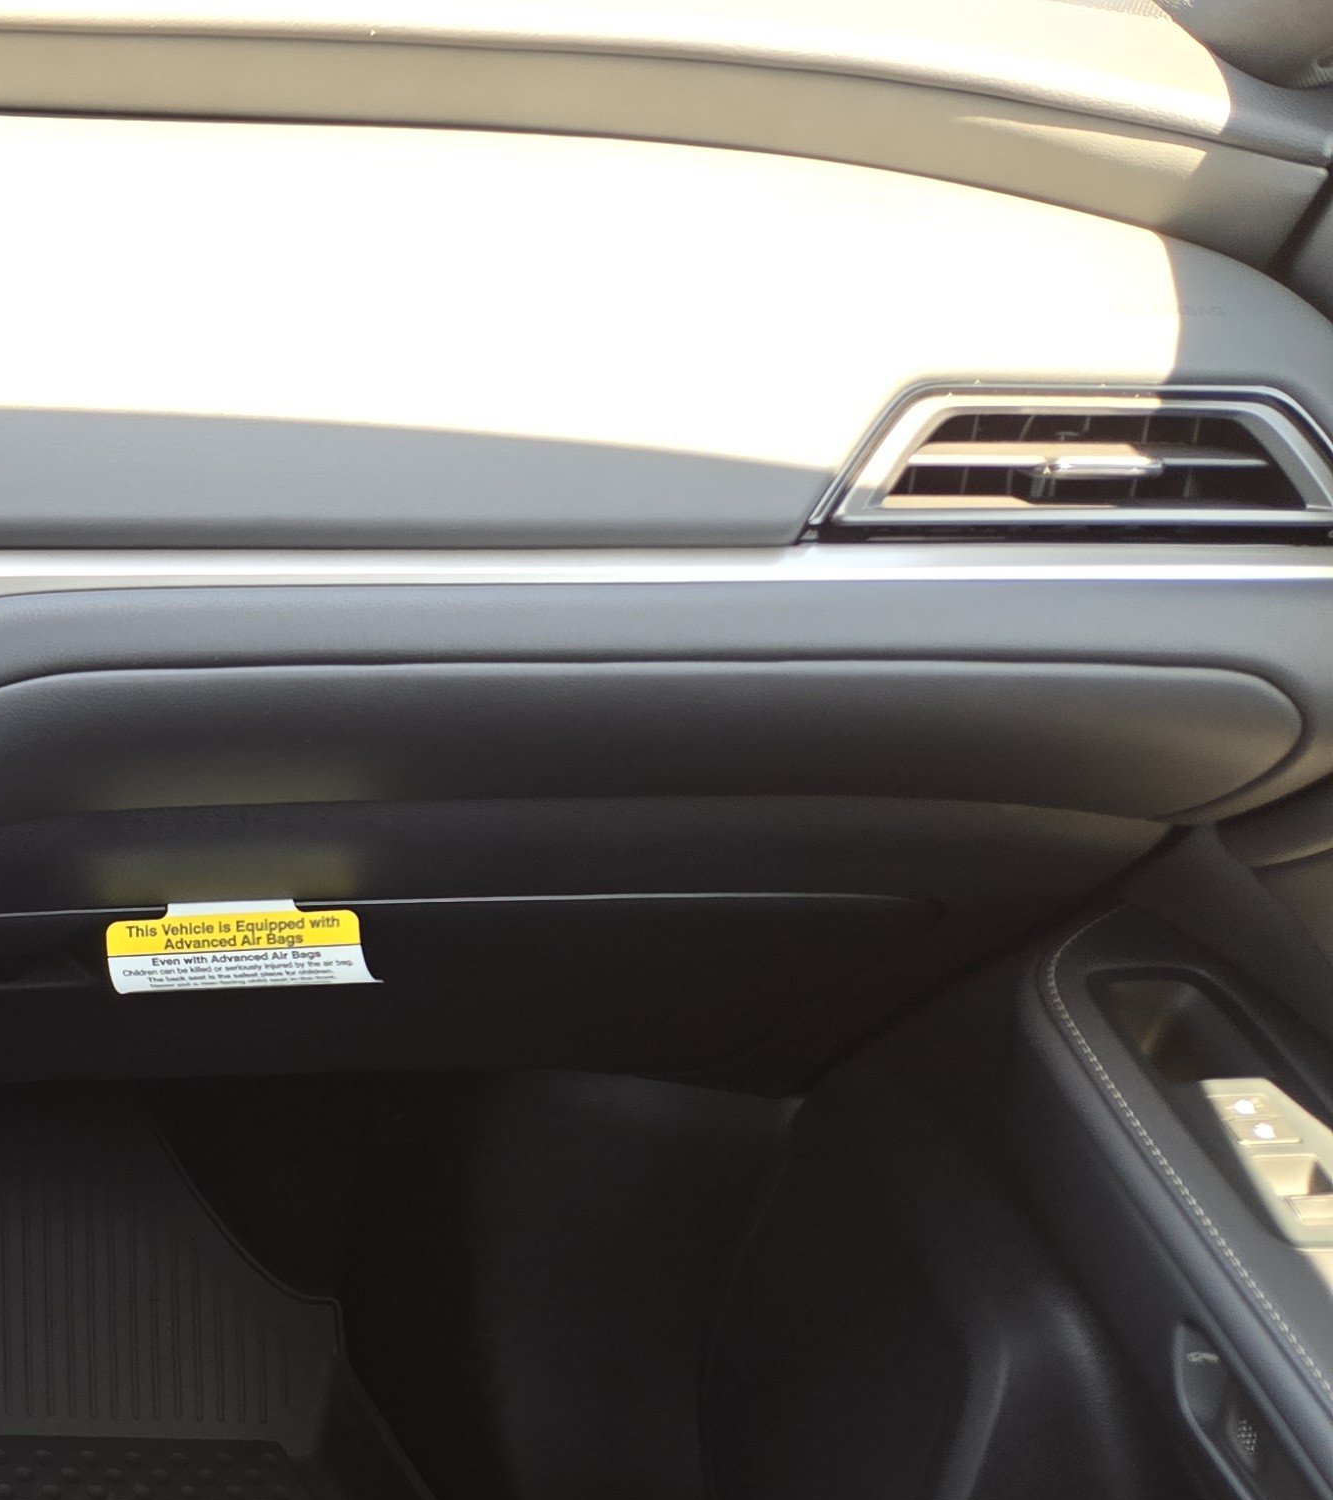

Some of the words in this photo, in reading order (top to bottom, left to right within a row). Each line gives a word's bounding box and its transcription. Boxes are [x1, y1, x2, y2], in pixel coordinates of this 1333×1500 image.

[126, 925, 157, 938] This
[162, 921, 214, 936] Vehicle
[219, 921, 231, 933] is
[236, 918, 305, 934] Equipped
[309, 915, 340, 928] with
[164, 935, 237, 951] Advanced
[241, 934, 262, 946] Air
[267, 933, 304, 948] Bags
[151, 957, 181, 967] Even
[183, 955, 208, 965] with
[211, 952, 269, 963] Advanced
[272, 951, 288, 961] Air
[292, 950, 322, 961] Bags
[122, 968, 159, 977] Children
[224, 963, 262, 972] seriously
[264, 961, 293, 971] injured
[295, 961, 304, 969] by
